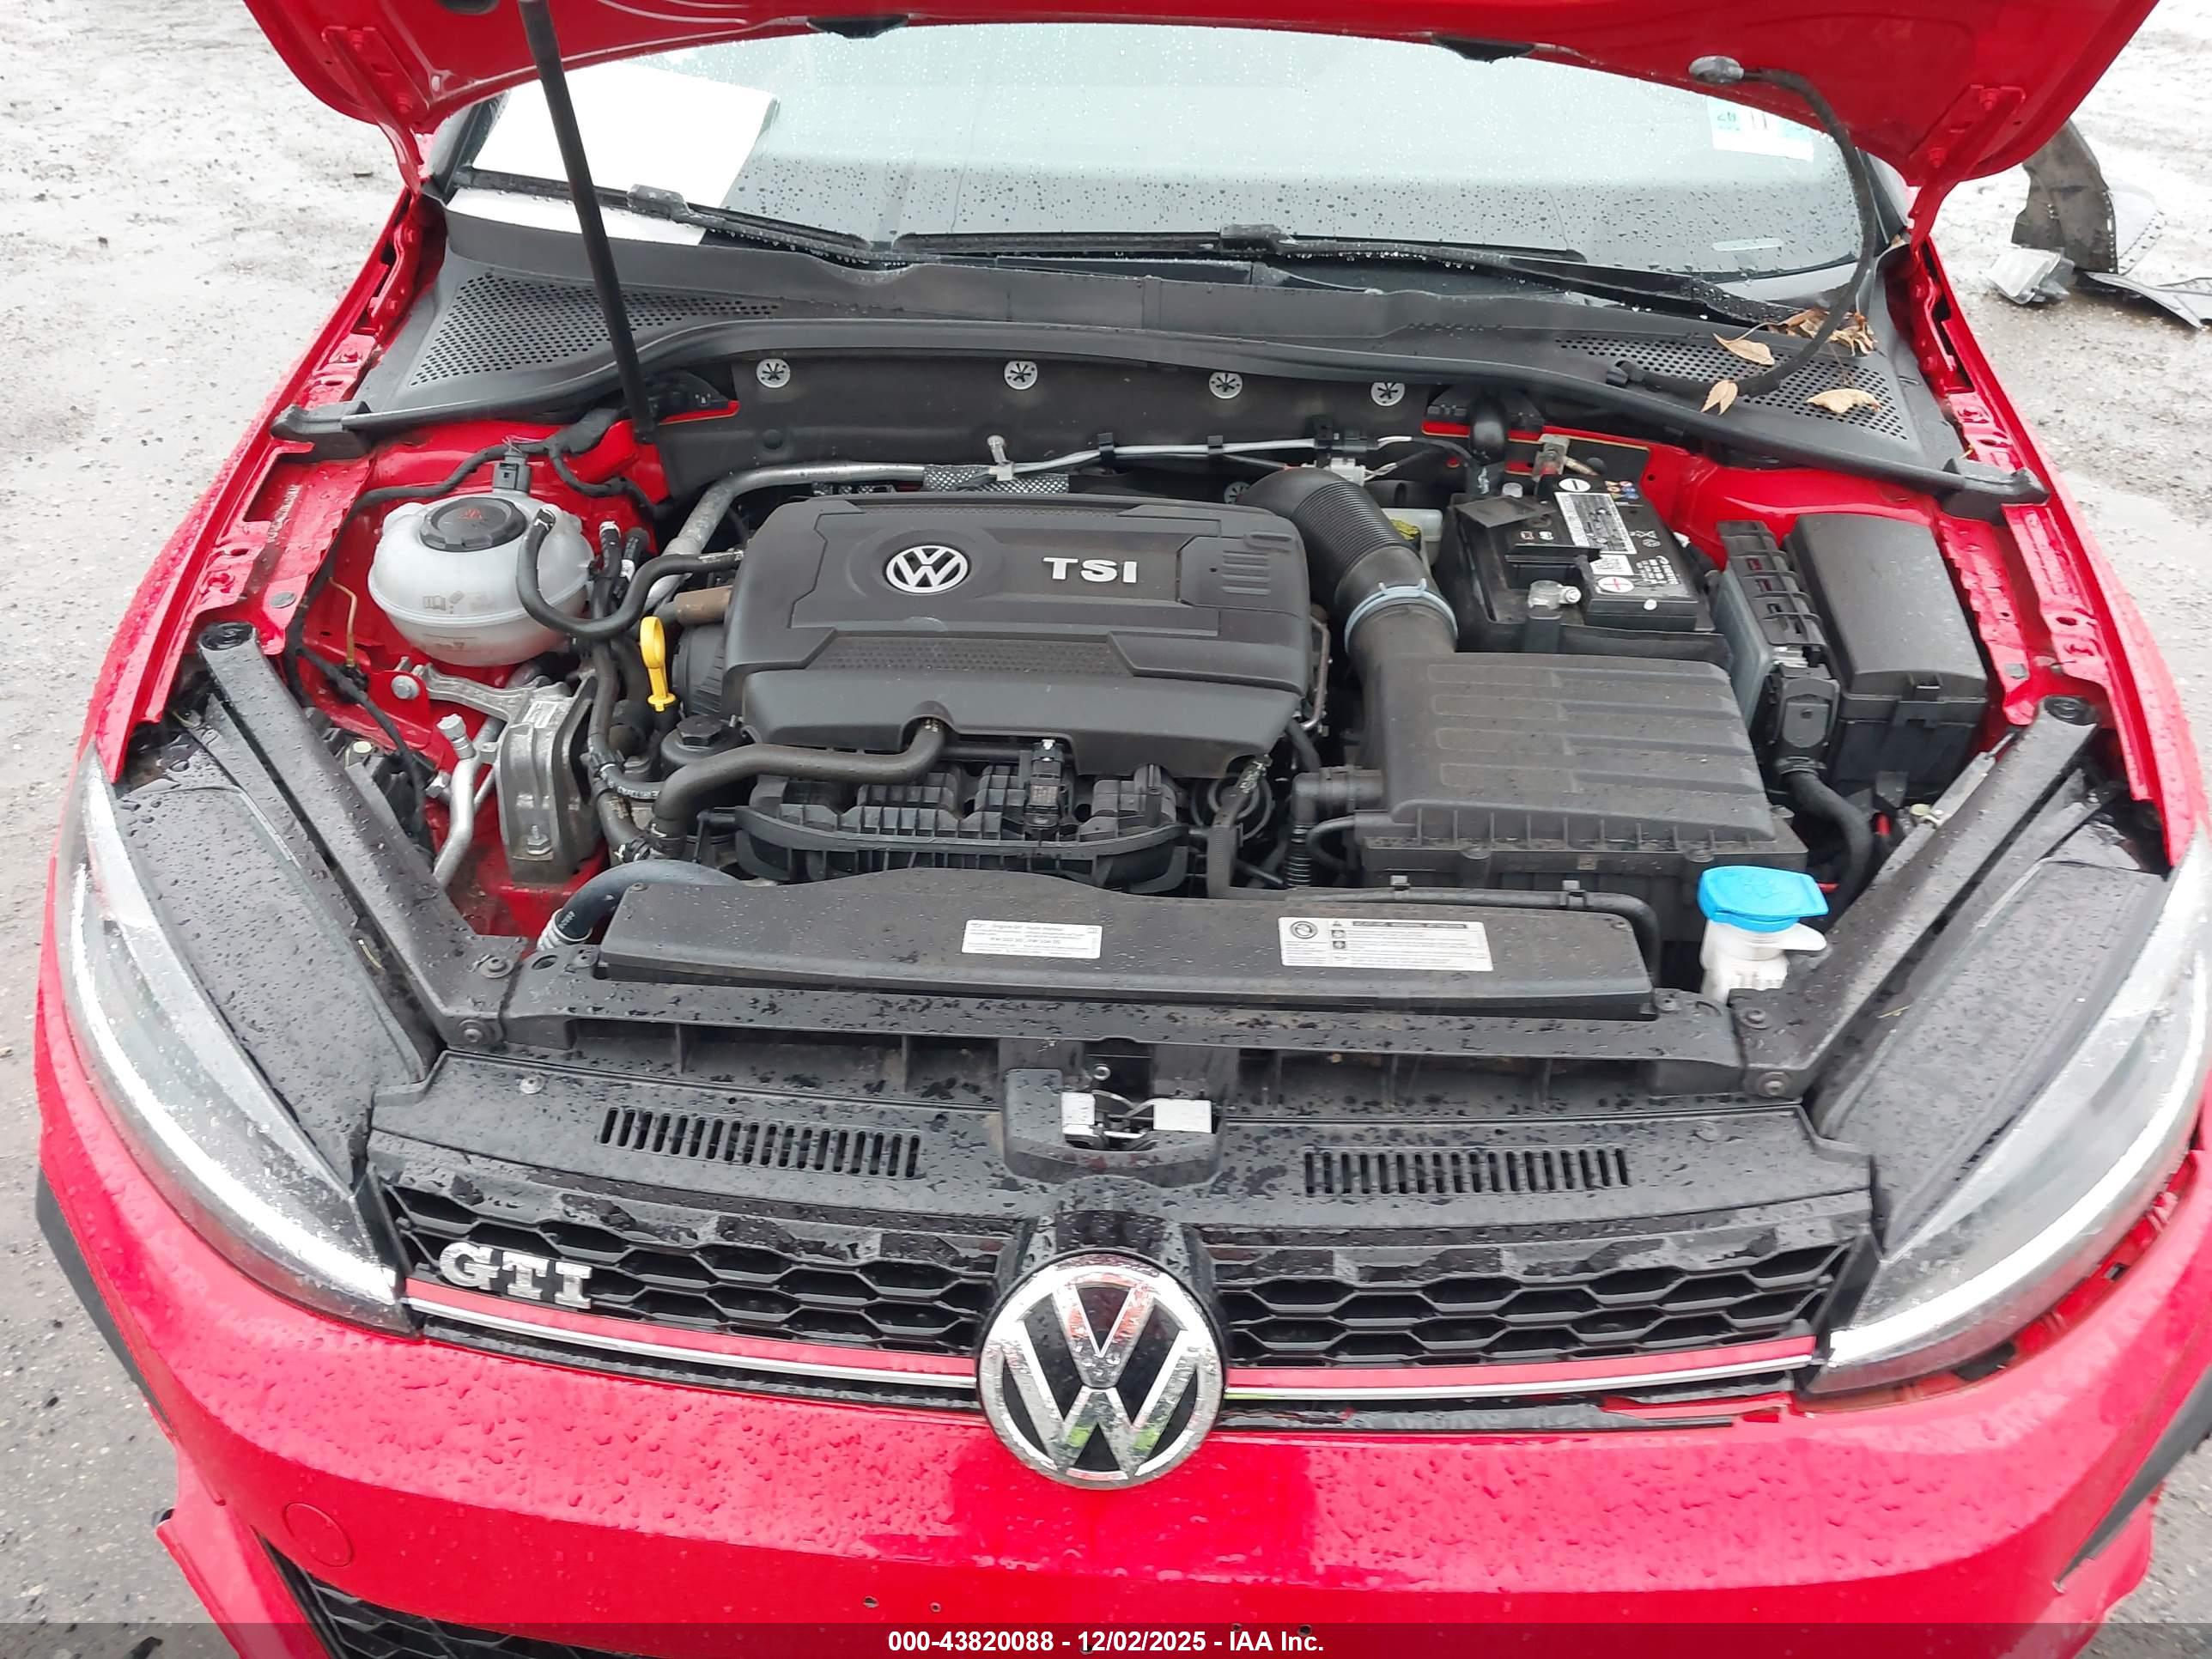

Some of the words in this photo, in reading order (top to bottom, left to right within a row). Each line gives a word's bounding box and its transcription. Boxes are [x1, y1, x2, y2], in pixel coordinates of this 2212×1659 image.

[886, 545, 969, 594] VW
[1042, 556, 1139, 584] TSI
[439, 1241, 593, 1310] GTI
[981, 1255, 1222, 1489] VW
